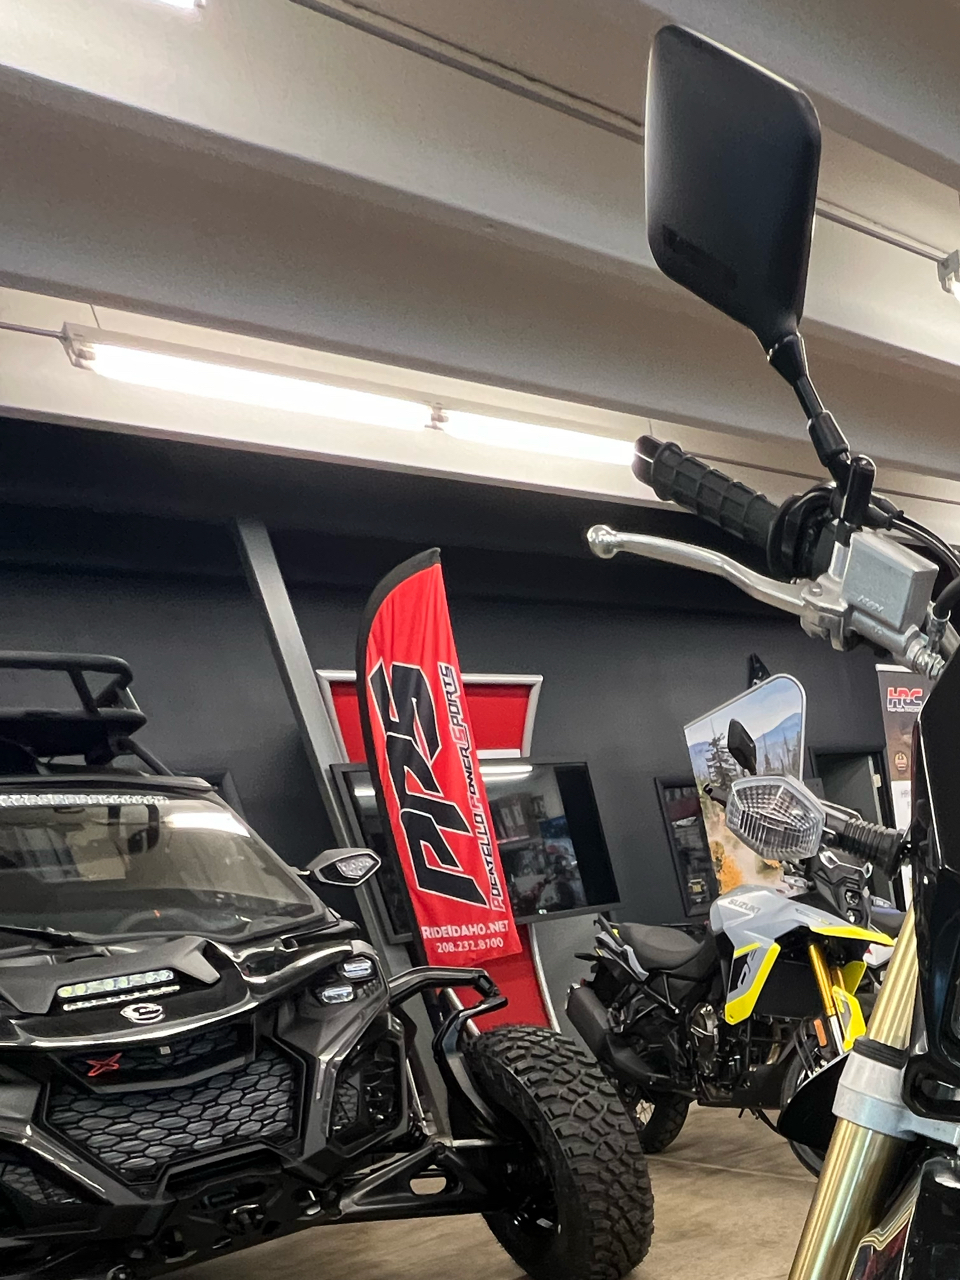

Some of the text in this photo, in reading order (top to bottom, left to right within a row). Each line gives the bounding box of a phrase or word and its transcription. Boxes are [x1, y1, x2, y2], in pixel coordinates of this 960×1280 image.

[887, 687, 923, 708] HRC
[727, 898, 762, 914] SUZUKI
[436, 936, 504, 954] 208.232.8100
